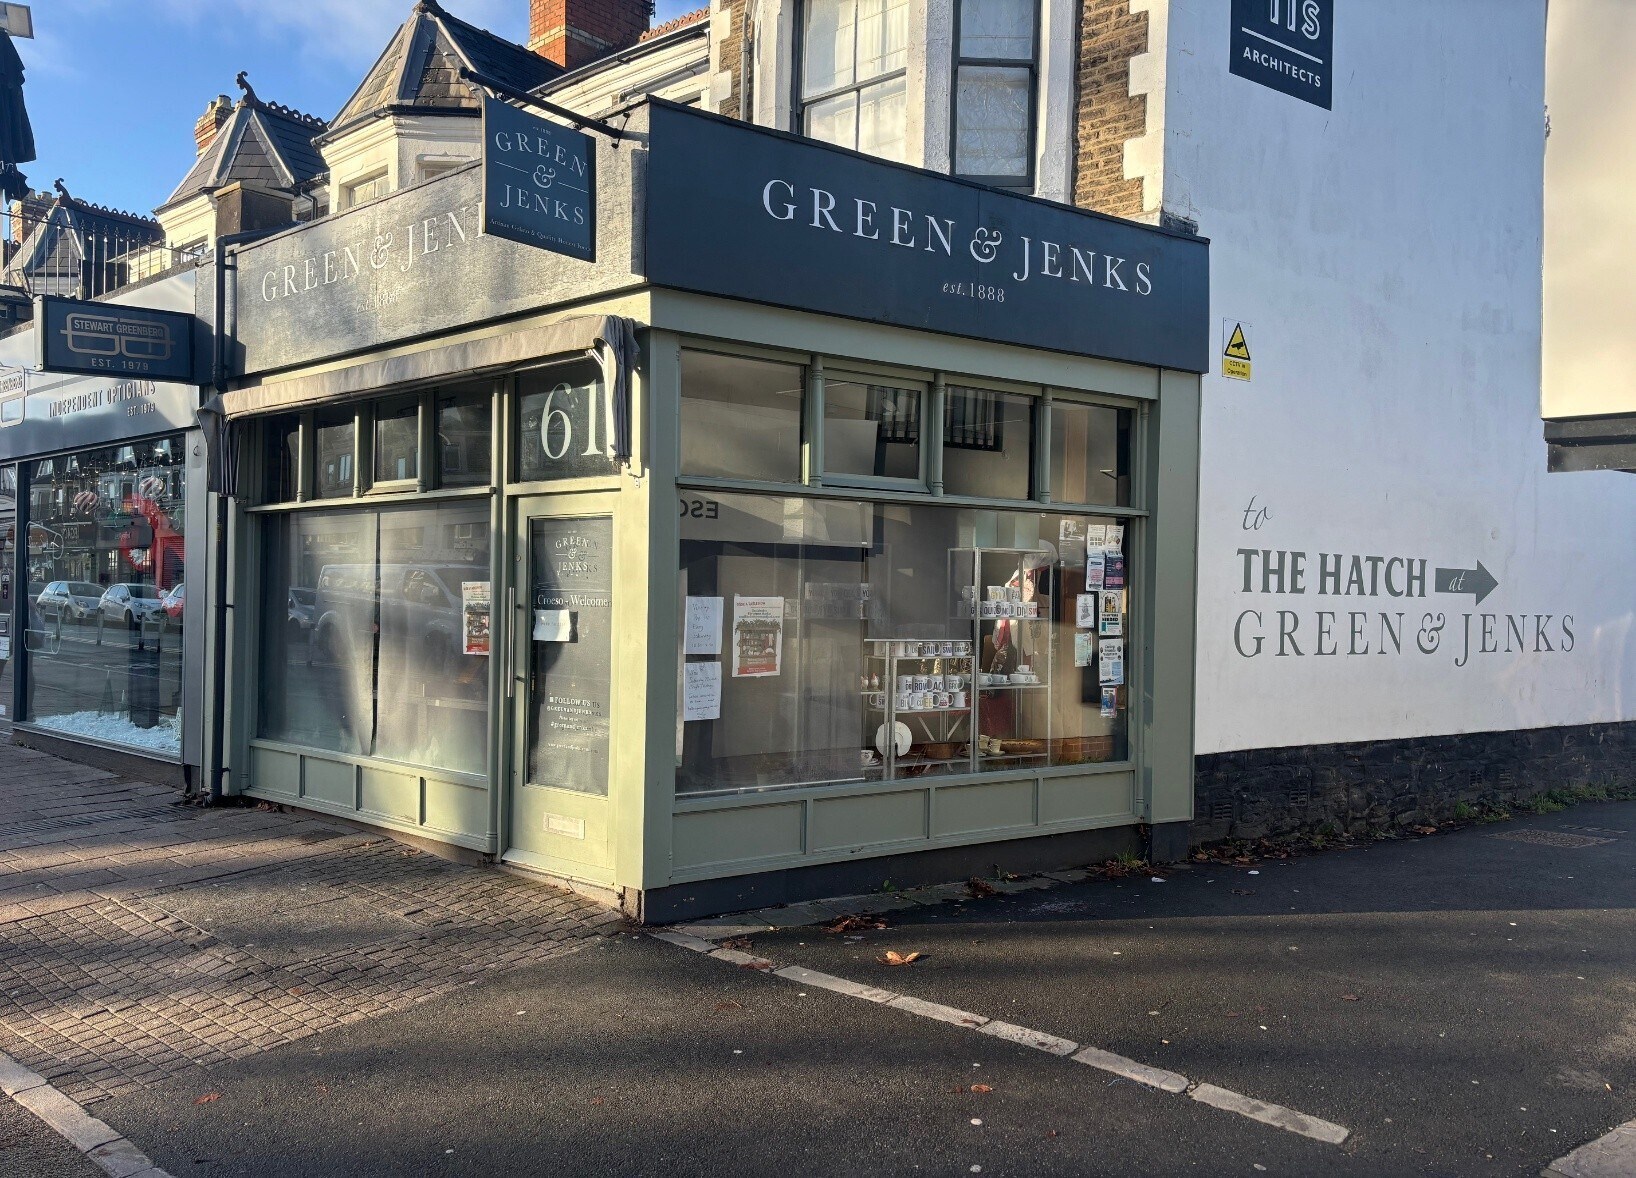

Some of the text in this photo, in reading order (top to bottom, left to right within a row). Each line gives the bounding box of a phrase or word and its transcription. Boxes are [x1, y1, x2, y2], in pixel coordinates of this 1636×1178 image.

[1243, 46, 1321, 88] ARCHITECTS
[495, 131, 588, 178] GREEN
[533, 164, 556, 189] &
[500, 184, 584, 225] JENKS
[762, 179, 1152, 295] GREEN & JENKS
[261, 241, 364, 302] GREEN
[370, 232, 393, 269] &
[74, 319, 164, 337] STEWART GREENBERG
[91, 358, 149, 371] EST. 1979
[49, 380, 156, 418] INDEPENDENT OPTICIANS
[141, 402, 156, 415] 1979
[541, 379, 603, 459] 61
[1242, 495, 1273, 530] to
[555, 536, 589, 549] GREEN
[567, 548, 577, 559] &
[556, 561, 588, 576] JENKS
[1237, 548, 1466, 598] THE HATCH at
[537, 594, 564, 606] Croeso
[570, 594, 609, 606] Welcome
[1233, 609, 1576, 668] GREEN & JENKS
